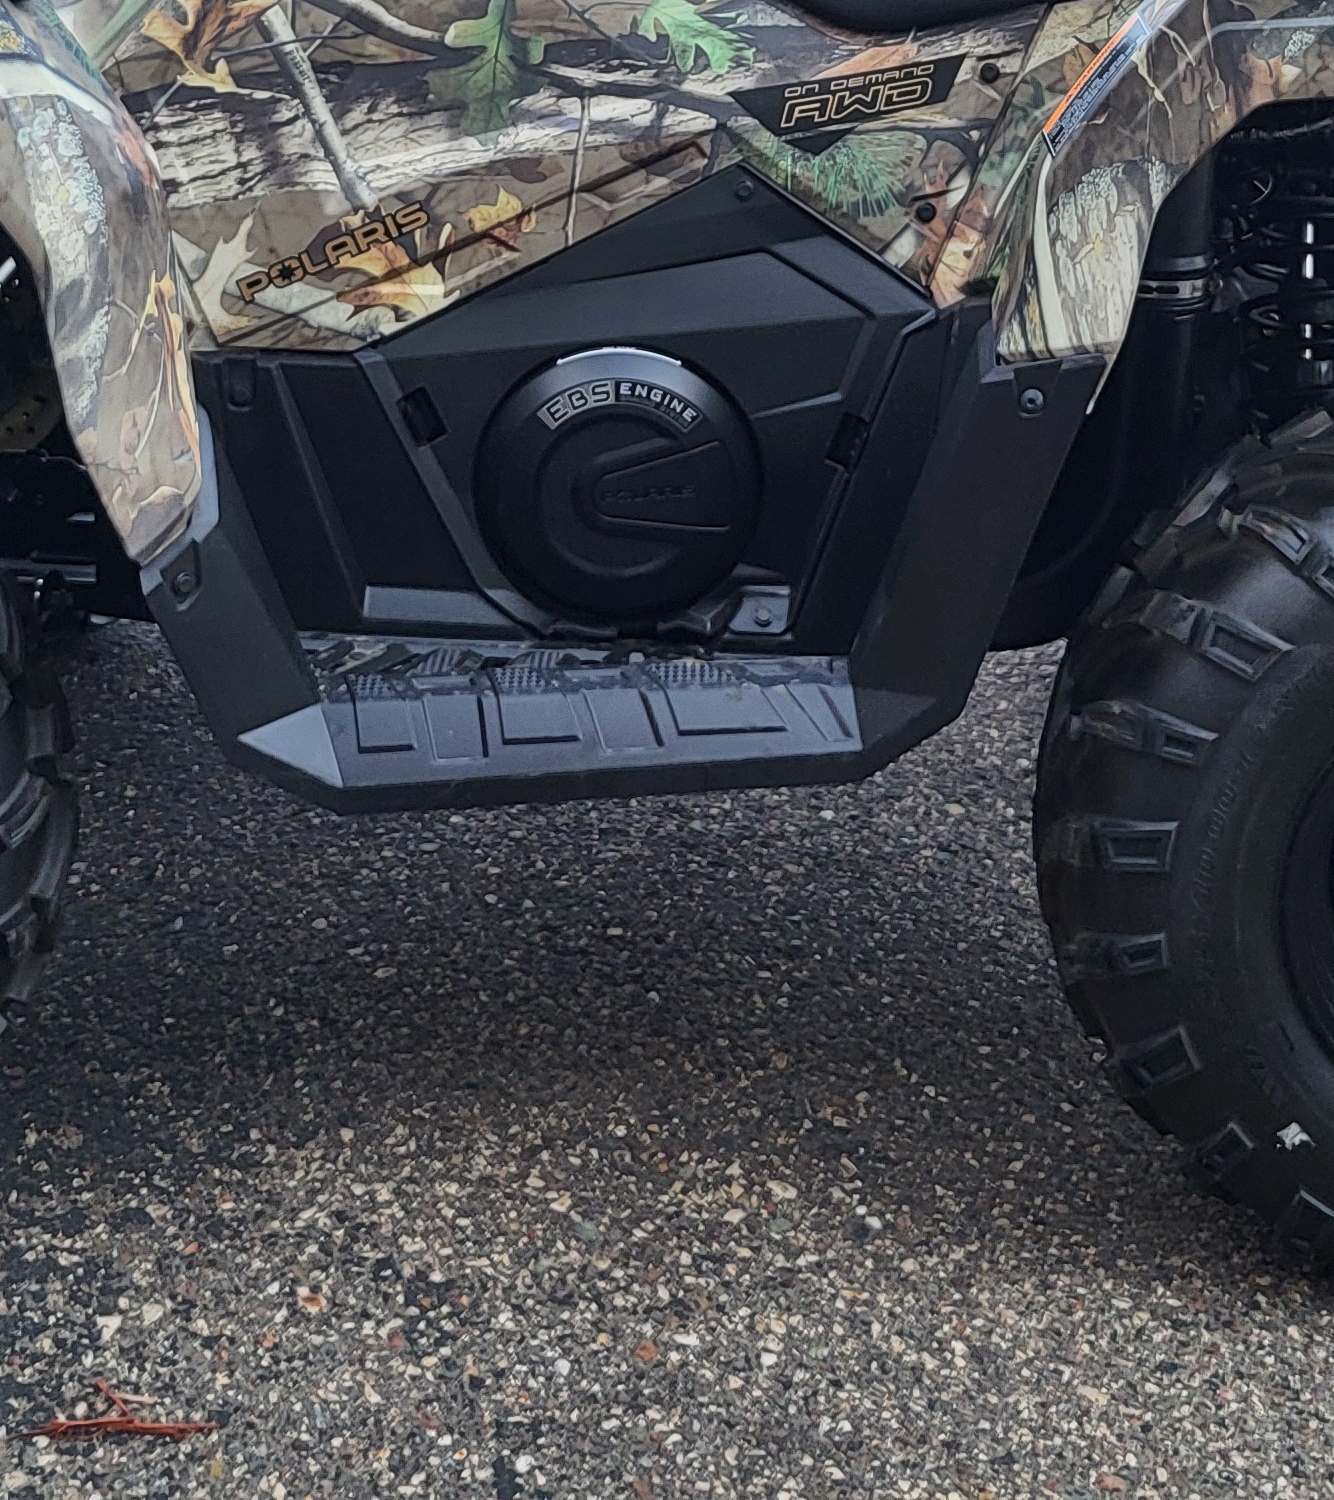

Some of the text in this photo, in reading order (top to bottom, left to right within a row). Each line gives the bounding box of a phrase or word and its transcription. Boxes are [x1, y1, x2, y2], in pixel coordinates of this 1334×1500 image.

[780, 77, 933, 128] AWD
[784, 64, 935, 97] ON DEMAND
[236, 200, 431, 303] POLARIS
[545, 381, 612, 424] EBS
[619, 381, 698, 423] ENGINE
